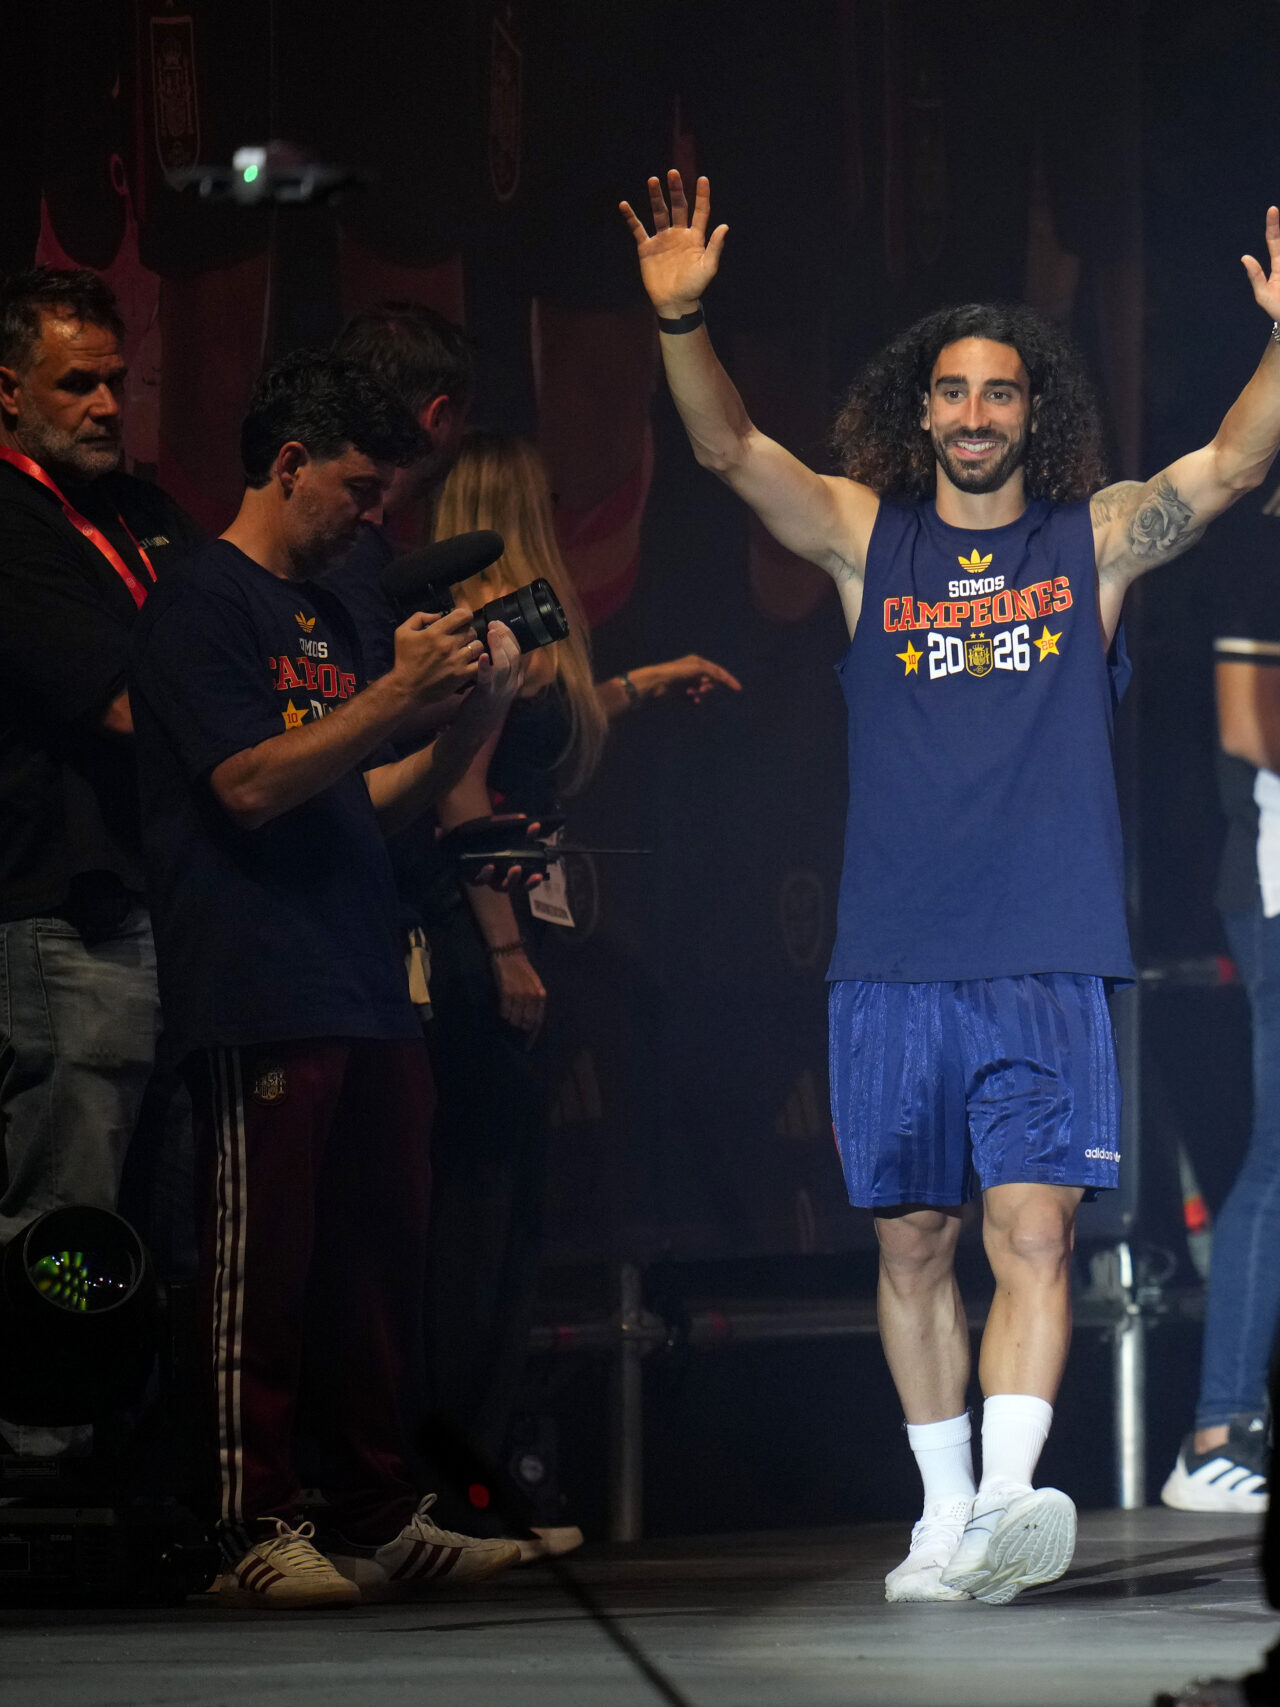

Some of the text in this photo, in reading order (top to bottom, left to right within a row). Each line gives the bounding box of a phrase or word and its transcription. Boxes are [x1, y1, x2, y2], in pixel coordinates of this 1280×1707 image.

[948, 574, 1005, 598] SOMOS
[883, 575, 1074, 633] CAMPEONES
[298, 637, 329, 659] OMOS
[908, 653, 917, 666] 10
[1040, 638, 1055, 651] 26
[287, 712, 299, 724] 10
[1084, 1146, 1113, 1161] adidas
